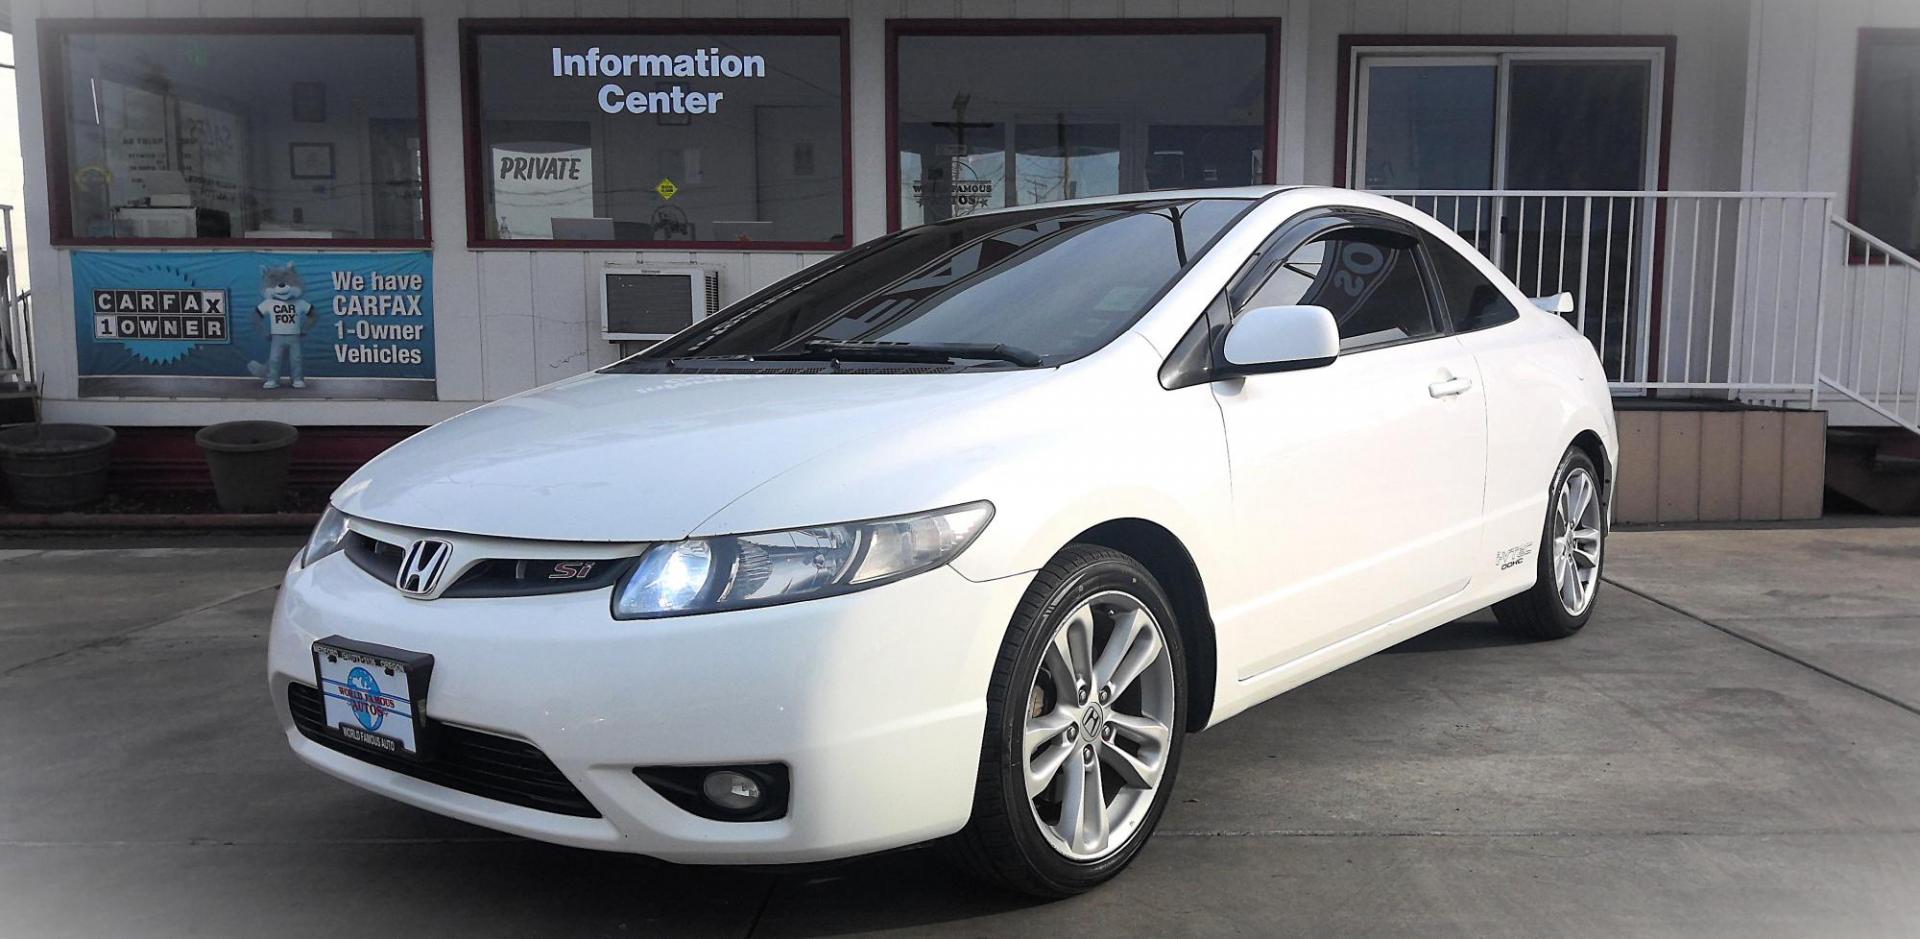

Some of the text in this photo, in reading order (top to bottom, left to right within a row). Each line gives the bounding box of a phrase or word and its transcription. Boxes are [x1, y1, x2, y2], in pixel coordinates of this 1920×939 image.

[551, 47, 766, 78] Information
[598, 84, 724, 114] Center
[500, 156, 581, 181] PRIVATE
[332, 271, 423, 291] We have
[98, 293, 224, 314] CARFAX
[273, 305, 296, 314] CAR
[332, 295, 423, 316] CARFAX
[275, 315, 296, 324] FOX
[334, 320, 424, 341] 1-Owner
[334, 344, 422, 364] Vehicles
[549, 561, 596, 579] Si
[338, 686, 395, 708] WORLD FAMOUS
[352, 701, 384, 715] AUTOS
[343, 727, 395, 751] WORLD FAMOUS AUTO
